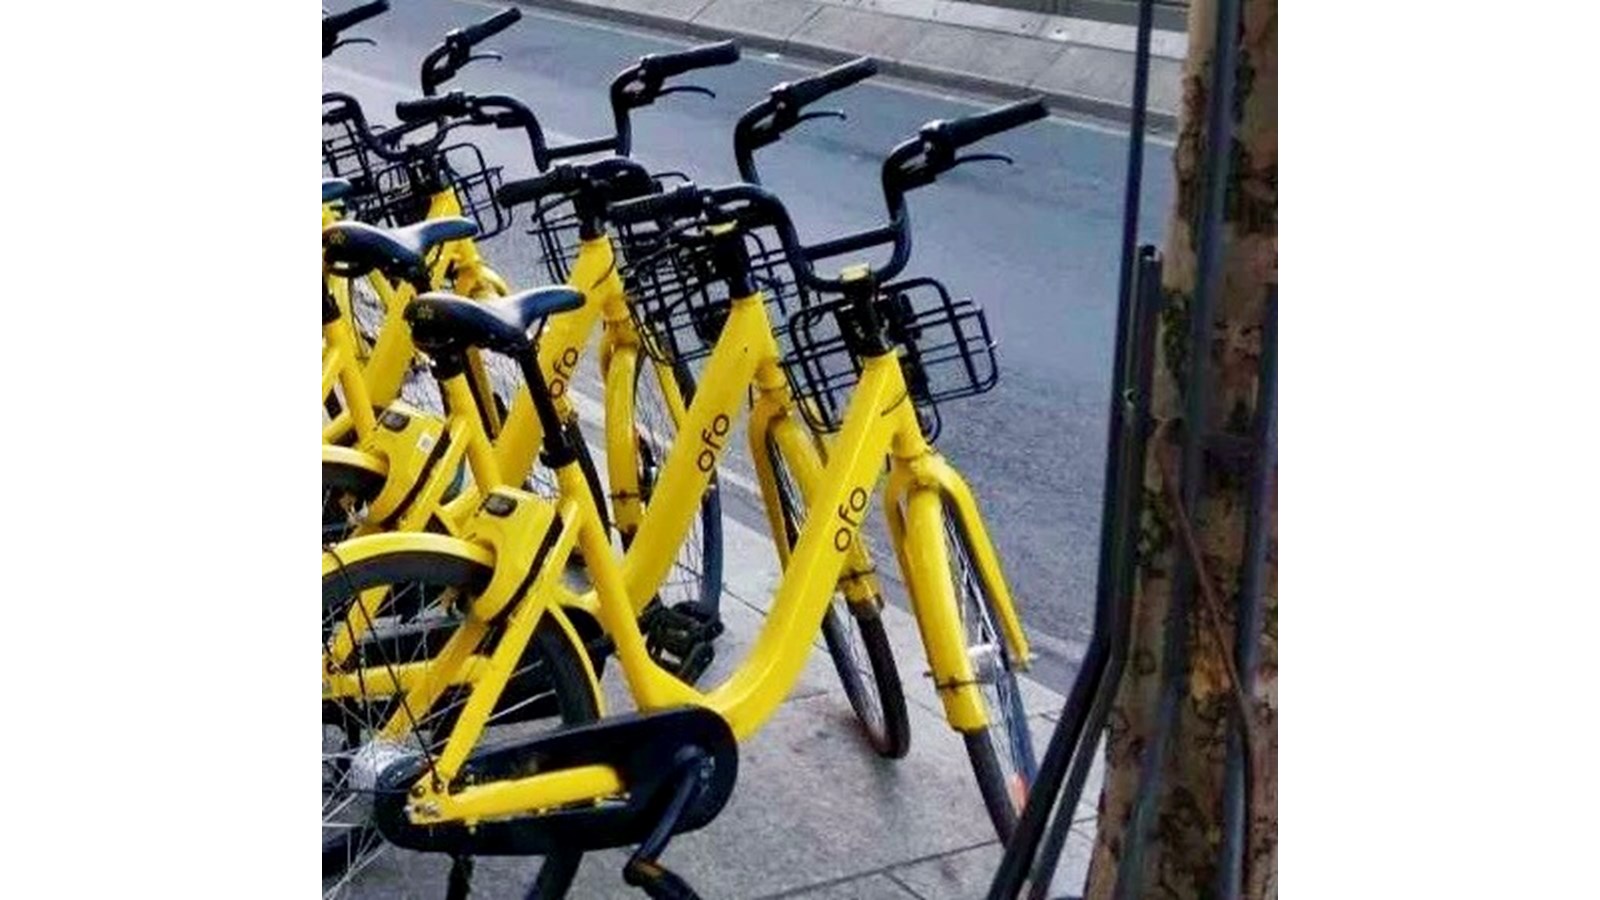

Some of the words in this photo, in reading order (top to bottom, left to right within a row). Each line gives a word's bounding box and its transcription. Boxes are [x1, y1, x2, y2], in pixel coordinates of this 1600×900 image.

[550, 347, 578, 399] ofo
[697, 413, 730, 473] ofo
[834, 487, 868, 552] ofo
